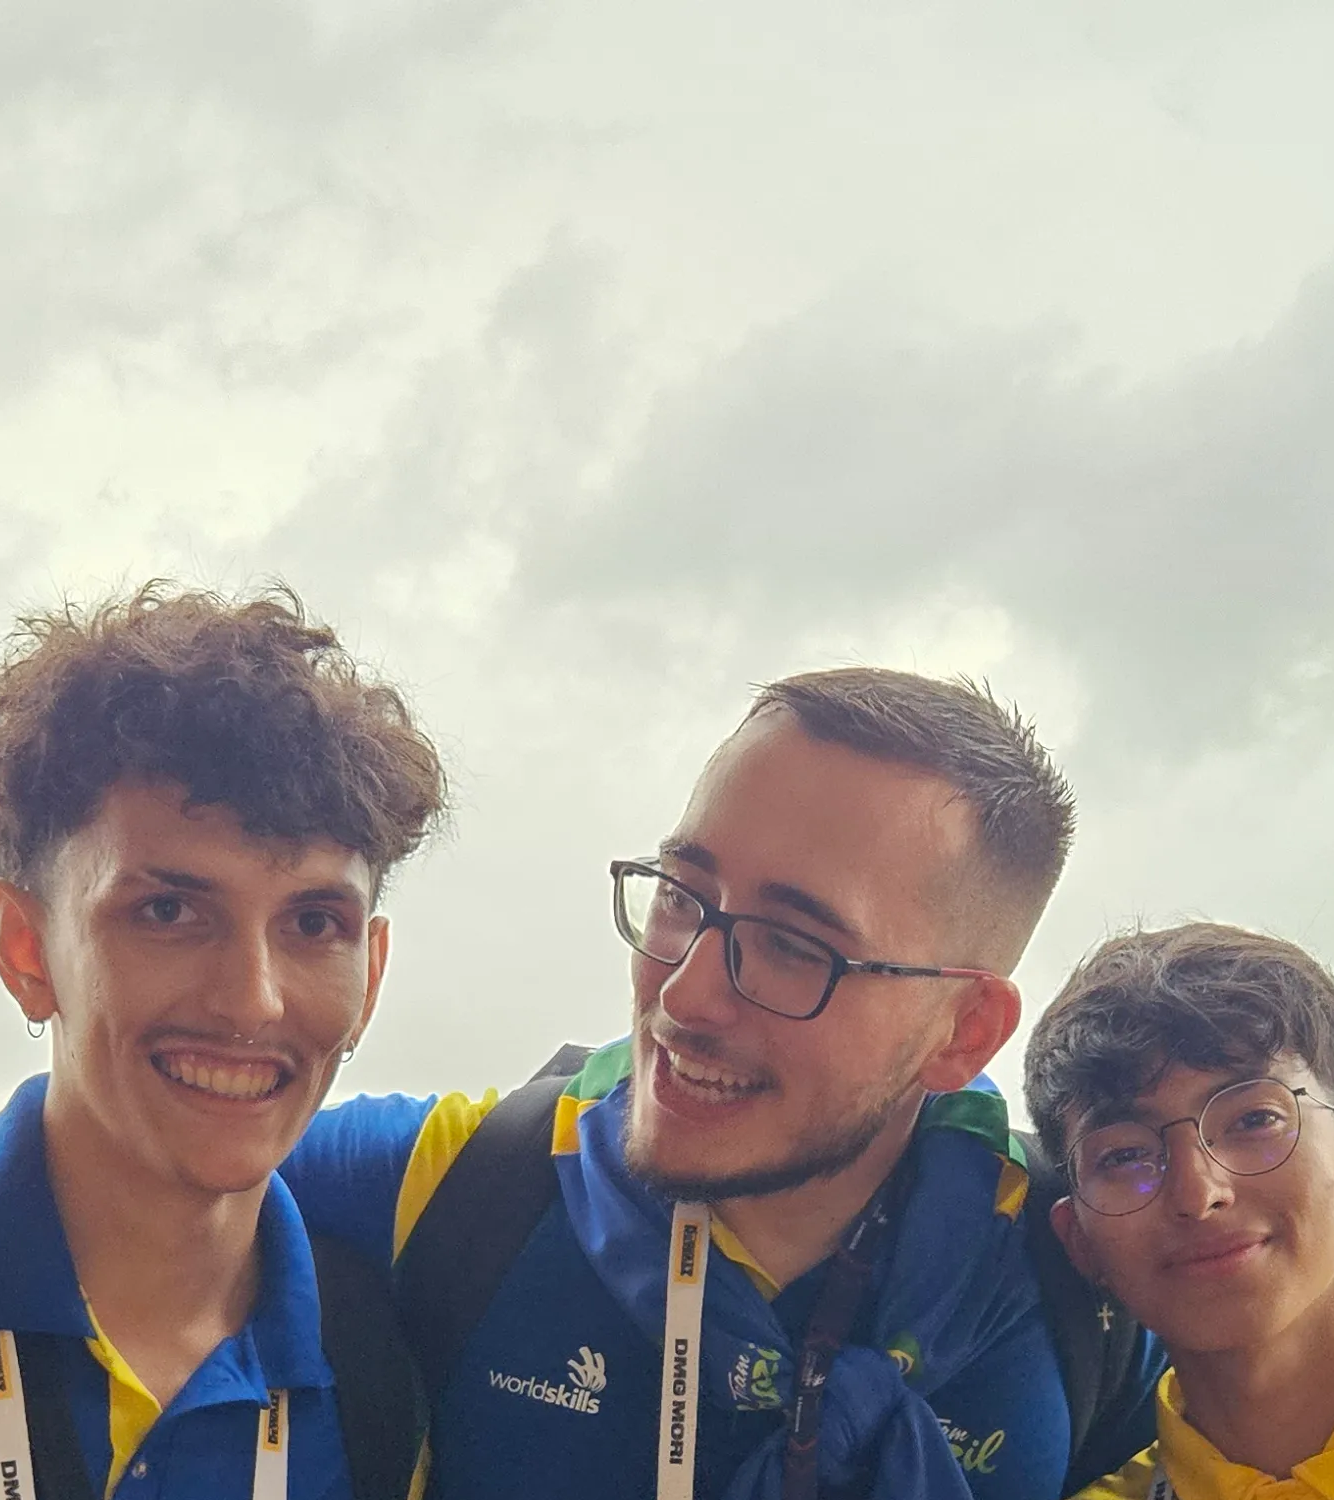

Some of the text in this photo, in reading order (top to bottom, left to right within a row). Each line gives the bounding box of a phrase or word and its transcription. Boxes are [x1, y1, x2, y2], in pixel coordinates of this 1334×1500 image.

[489, 1368, 601, 1415] worldskills
[670, 1338, 688, 1466] DMG MORI
